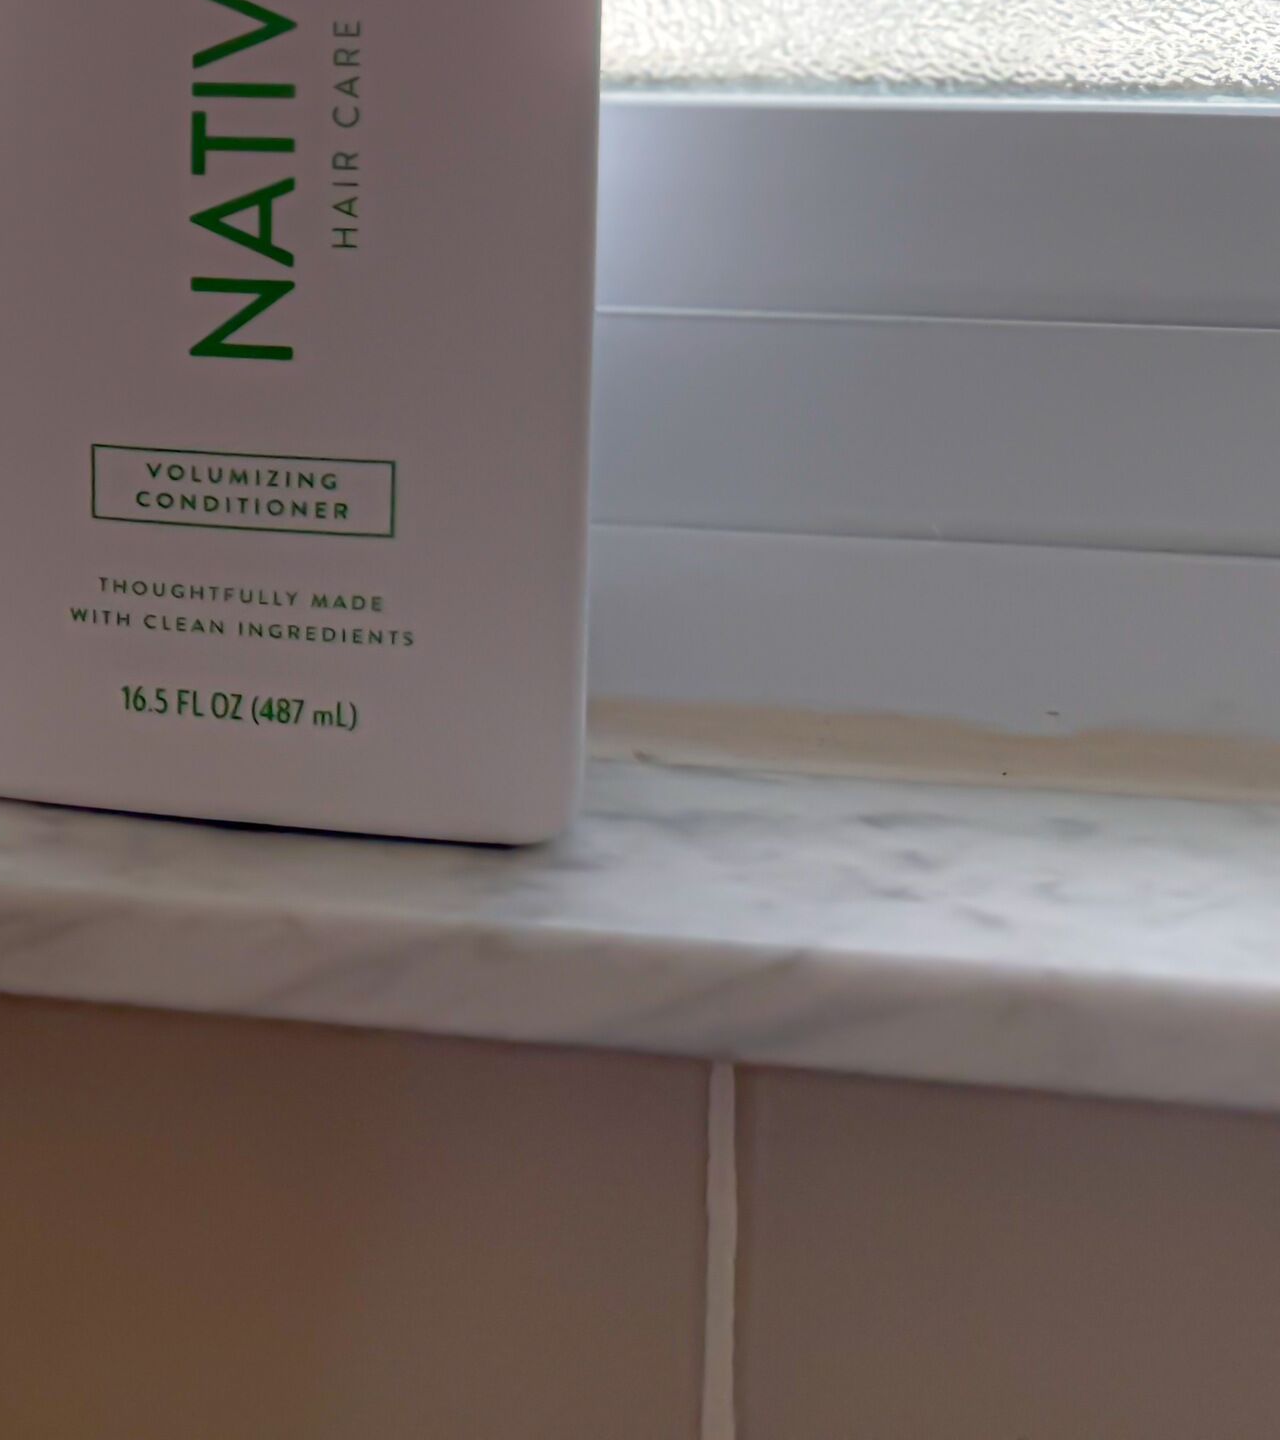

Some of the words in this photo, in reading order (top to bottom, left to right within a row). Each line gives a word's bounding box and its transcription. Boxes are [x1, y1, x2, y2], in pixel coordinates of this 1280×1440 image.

[331, 21, 363, 130] CARE
[331, 151, 359, 250] HAIR
[145, 462, 339, 492] VOLUMIZING
[135, 490, 350, 520] CONDITIONER
[98, 576, 298, 607] THOUGHTFULLY
[310, 593, 383, 613] MADE
[70, 607, 131, 627] WITH
[142, 613, 226, 635] CLEAN
[237, 621, 415, 647] INGREDIENTS
[121, 685, 170, 715] 16.5
[176, 688, 205, 719] FL
[210, 691, 244, 722] OZ
[250, 696, 305, 726] (487
[312, 701, 359, 732] mL)
